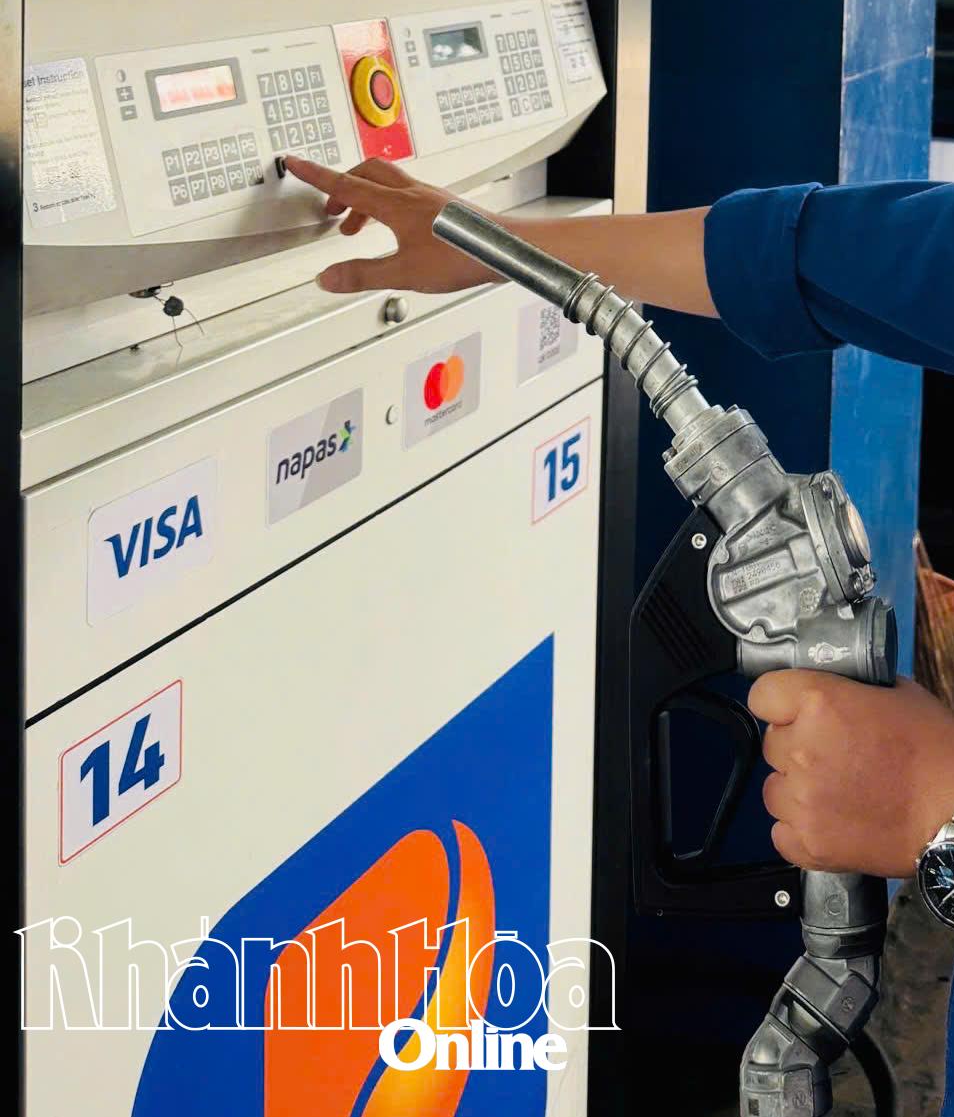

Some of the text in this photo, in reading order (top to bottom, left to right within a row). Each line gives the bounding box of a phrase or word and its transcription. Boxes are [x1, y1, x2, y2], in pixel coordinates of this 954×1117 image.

[260, 77, 270, 95] 7
[278, 74, 288, 92] 8
[295, 71, 304, 89] 9
[267, 103, 277, 122] 4
[285, 101, 294, 119] 5
[301, 98, 311, 115] 6
[273, 130, 282, 149] 1
[290, 127, 300, 145] 2
[305, 124, 315, 141] 3
[164, 154, 181, 172] P1
[184, 151, 200, 168] P2
[204, 146, 220, 164] P3
[223, 142, 238, 159] P4
[172, 184, 188, 202] P6
[191, 179, 206, 197] P7
[210, 173, 226, 191] P8
[230, 168, 244, 186] P9
[424, 400, 463, 427] mastercard
[276, 430, 338, 485] napas
[543, 433, 581, 503] 15
[104, 494, 204, 579] VISA
[80, 713, 166, 827] 14
